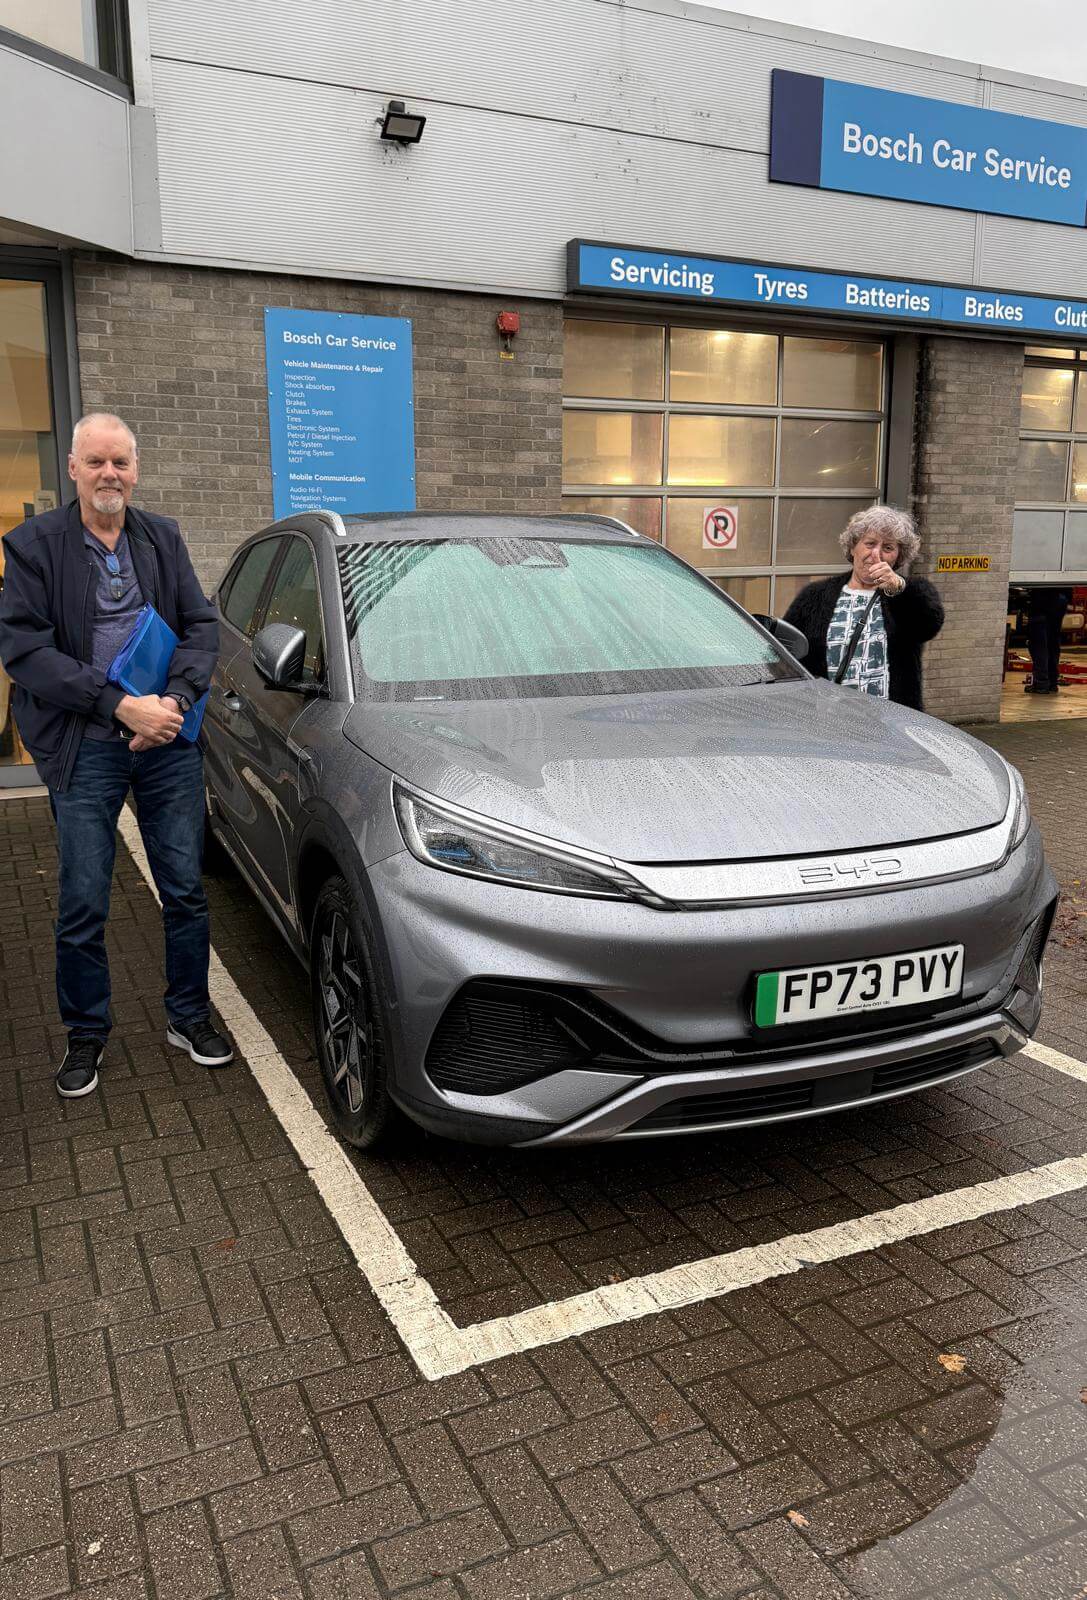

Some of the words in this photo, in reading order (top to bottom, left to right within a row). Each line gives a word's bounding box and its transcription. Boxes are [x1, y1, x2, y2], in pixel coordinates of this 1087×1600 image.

[843, 122, 923, 164] Bosch
[932, 139, 976, 172] Car
[983, 148, 1071, 188] Service
[610, 257, 715, 295] Servicing
[754, 273, 808, 300] Tyres
[845, 283, 930, 312] Batteries
[965, 296, 1023, 321] Brakes
[283, 331, 322, 345] Bosch
[326, 334, 348, 347] Car
[352, 336, 397, 351] Service
[283, 359, 309, 368] Vehicle
[310, 361, 354, 371] Maintenance
[361, 365, 384, 374] Repair
[284, 373, 316, 382] Inspection
[305, 383, 336, 391] absorbers
[285, 390, 305, 398] Clutch
[286, 407, 310, 415] Exhaust
[311, 408, 333, 417] System
[286, 415, 302, 423] Tires
[286, 424, 317, 432] Electronic
[318, 425, 340, 434] System
[311, 433, 330, 441] Diesel
[331, 434, 357, 442] Injection
[301, 441, 323, 449] System
[288, 449, 311, 457] Heating
[312, 449, 335, 457] System
[289, 473, 313, 481] Mobile
[314, 474, 366, 483] Communication
[290, 494, 321, 502] Navigation
[322, 495, 347, 503] Systems
[713, 515, 729, 539] P
[798, 856, 903, 884] BYD
[783, 963, 882, 1013] FP73
[892, 951, 959, 997] PVY
